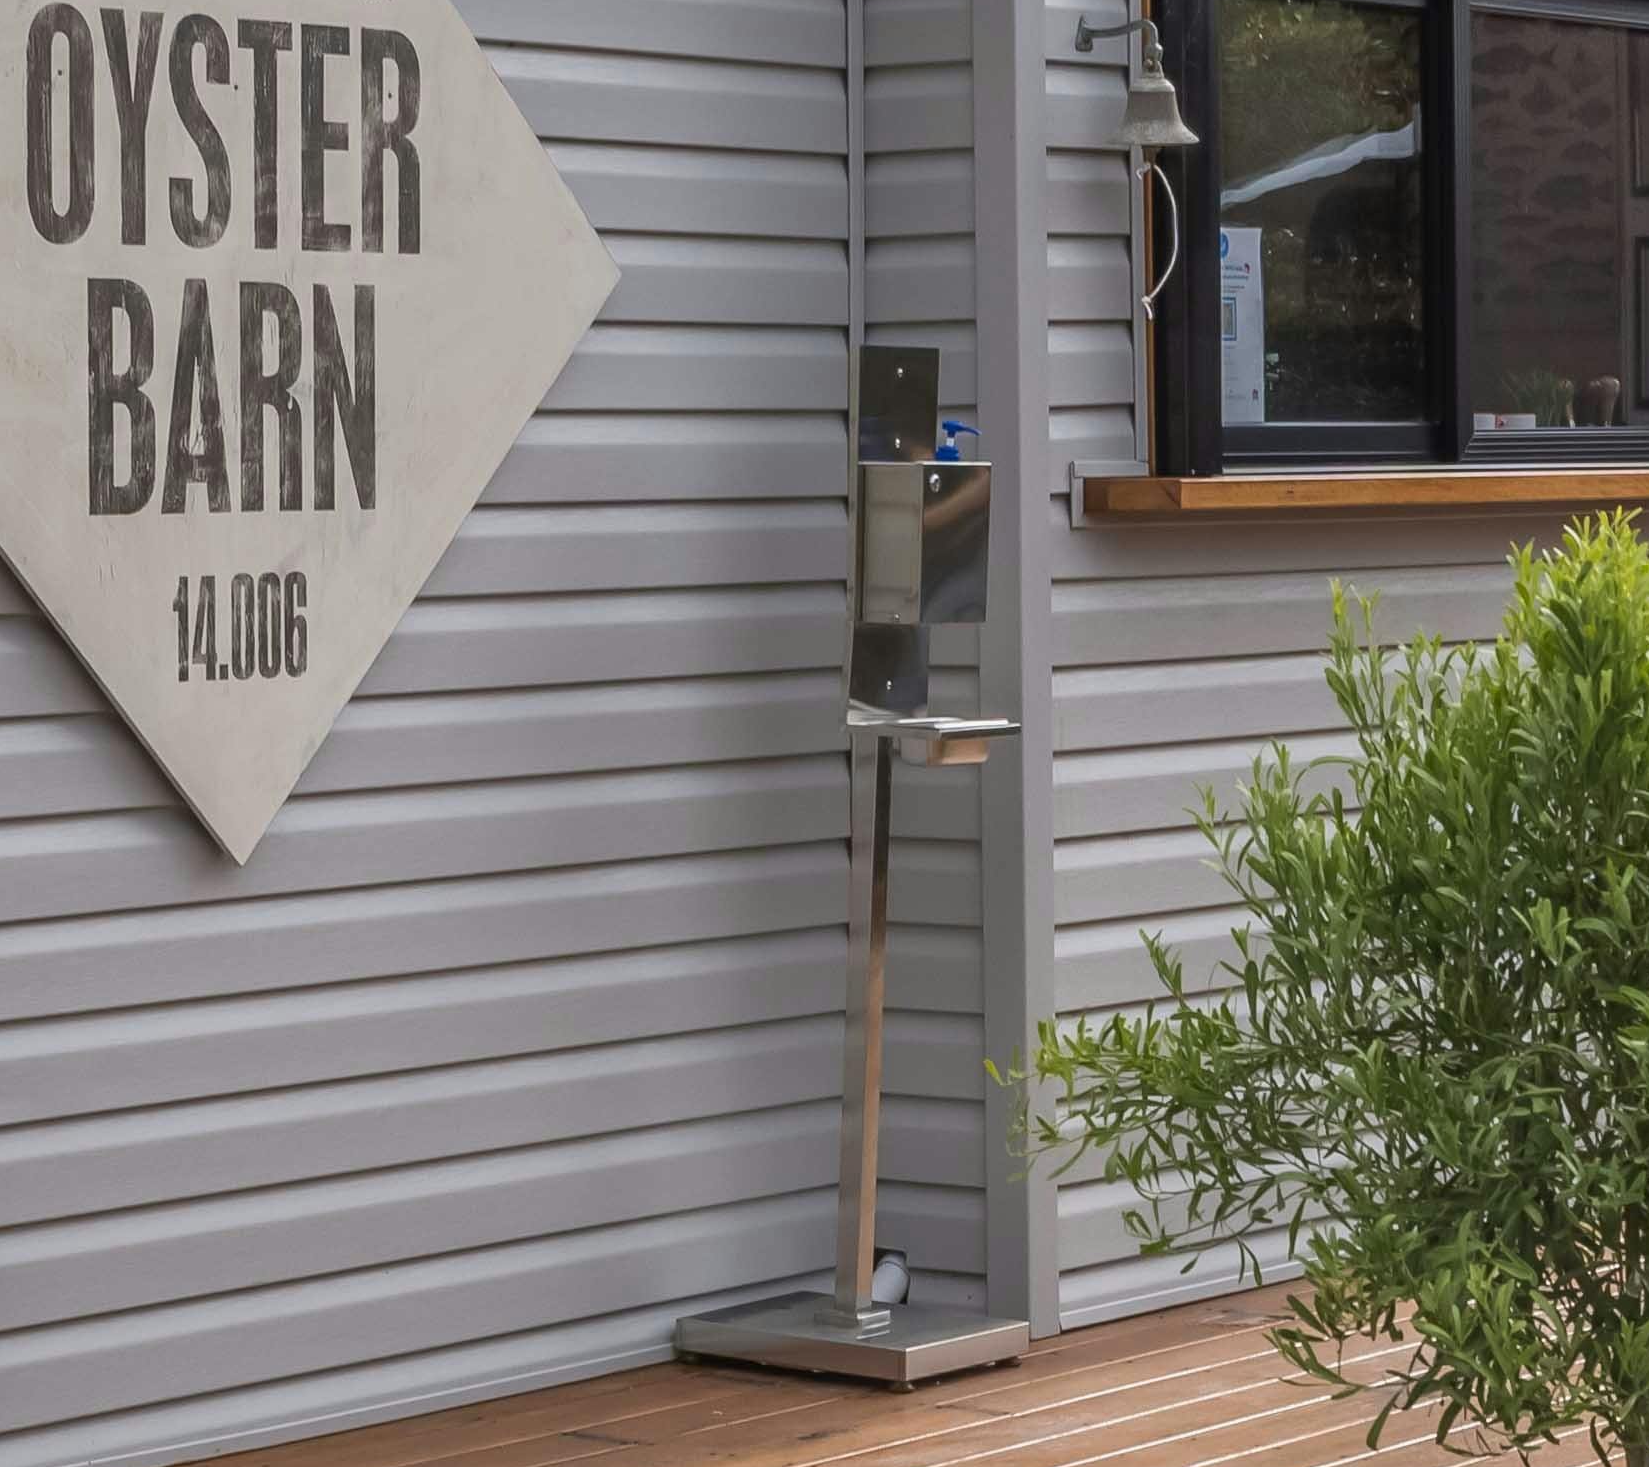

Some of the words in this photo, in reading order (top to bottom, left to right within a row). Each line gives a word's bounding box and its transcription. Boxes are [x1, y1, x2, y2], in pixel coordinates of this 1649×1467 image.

[23, 2, 423, 255] OYSTER
[85, 277, 378, 517] BARN
[172, 571, 309, 683] 14.006
